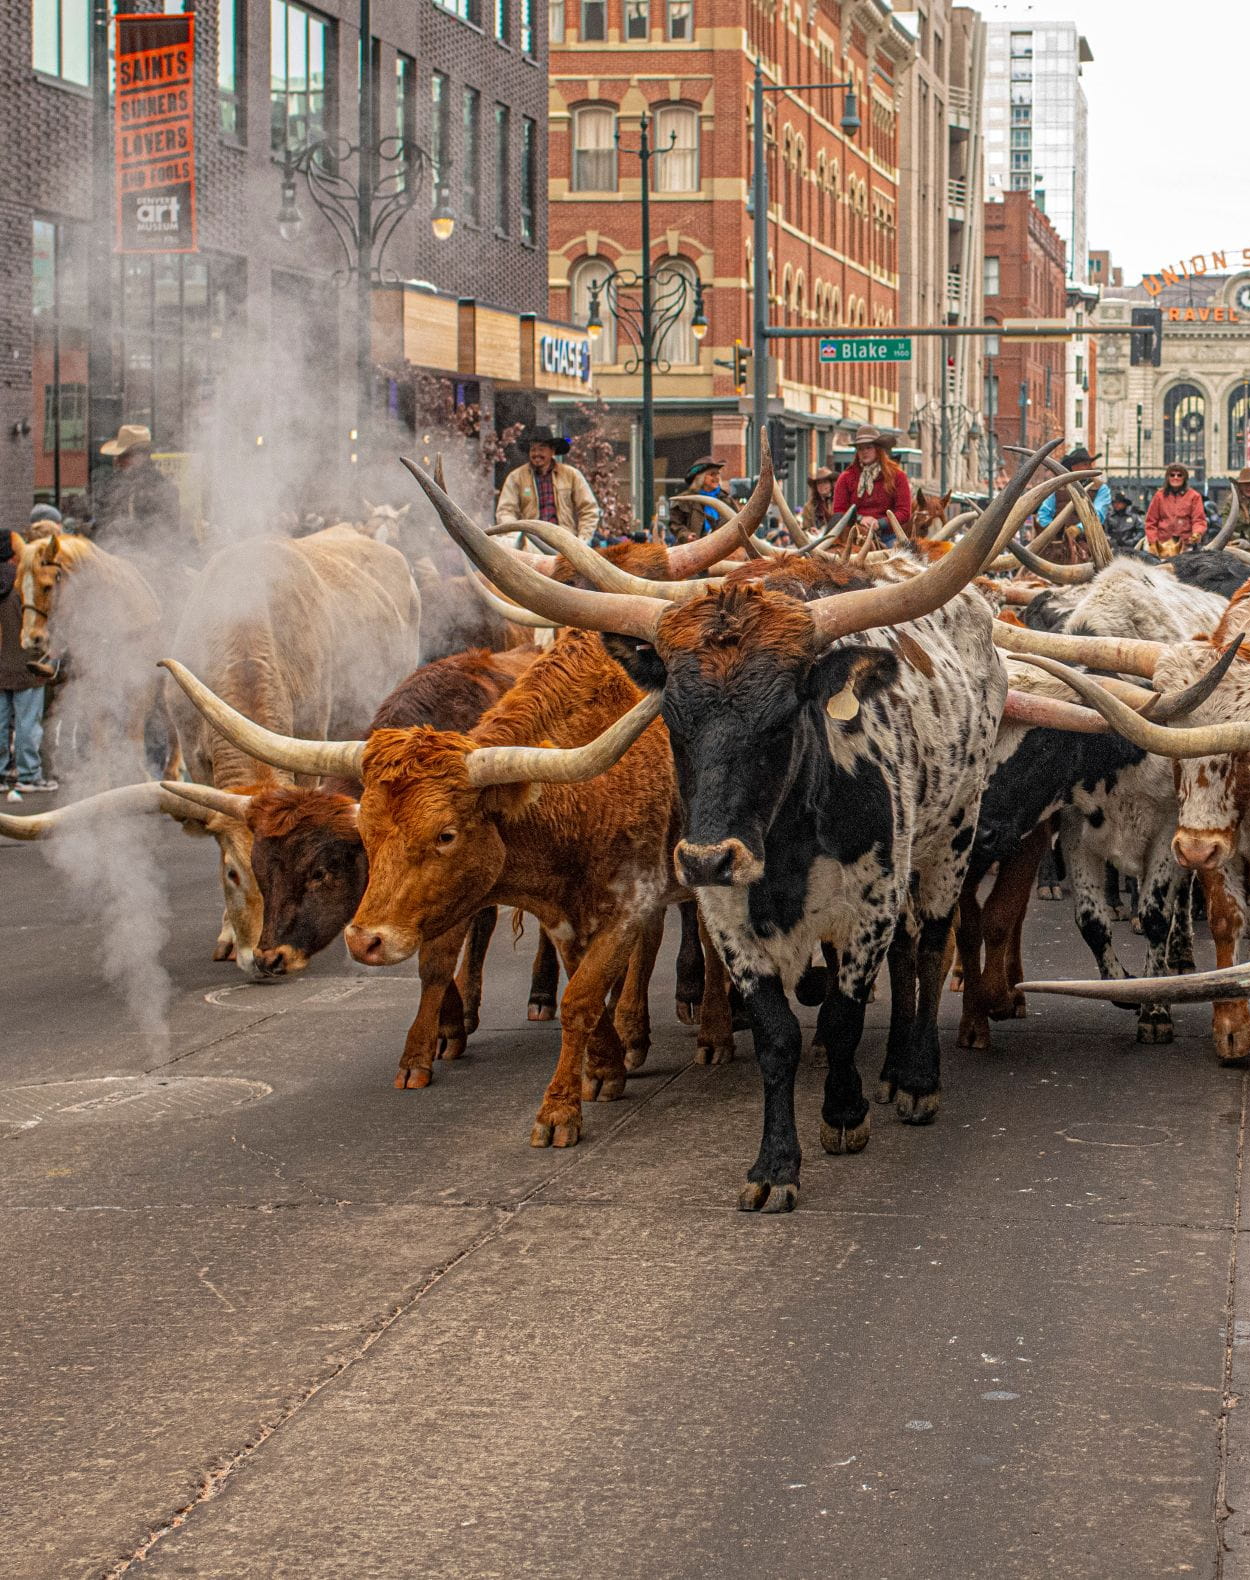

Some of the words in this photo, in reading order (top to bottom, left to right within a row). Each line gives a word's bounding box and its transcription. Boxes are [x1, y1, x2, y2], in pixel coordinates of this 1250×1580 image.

[121, 51, 188, 86] SAINTS
[121, 90, 189, 121] SINNERS
[122, 127, 187, 158] LOVERS
[150, 162, 189, 183] FOOLS
[136, 196, 180, 223] art
[136, 222, 179, 232] MUSEUM
[1142, 249, 1228, 297] UNION
[1160, 307, 1240, 322] RAVEL
[541, 336, 583, 378] CHASE
[842, 342, 888, 358] Blake
